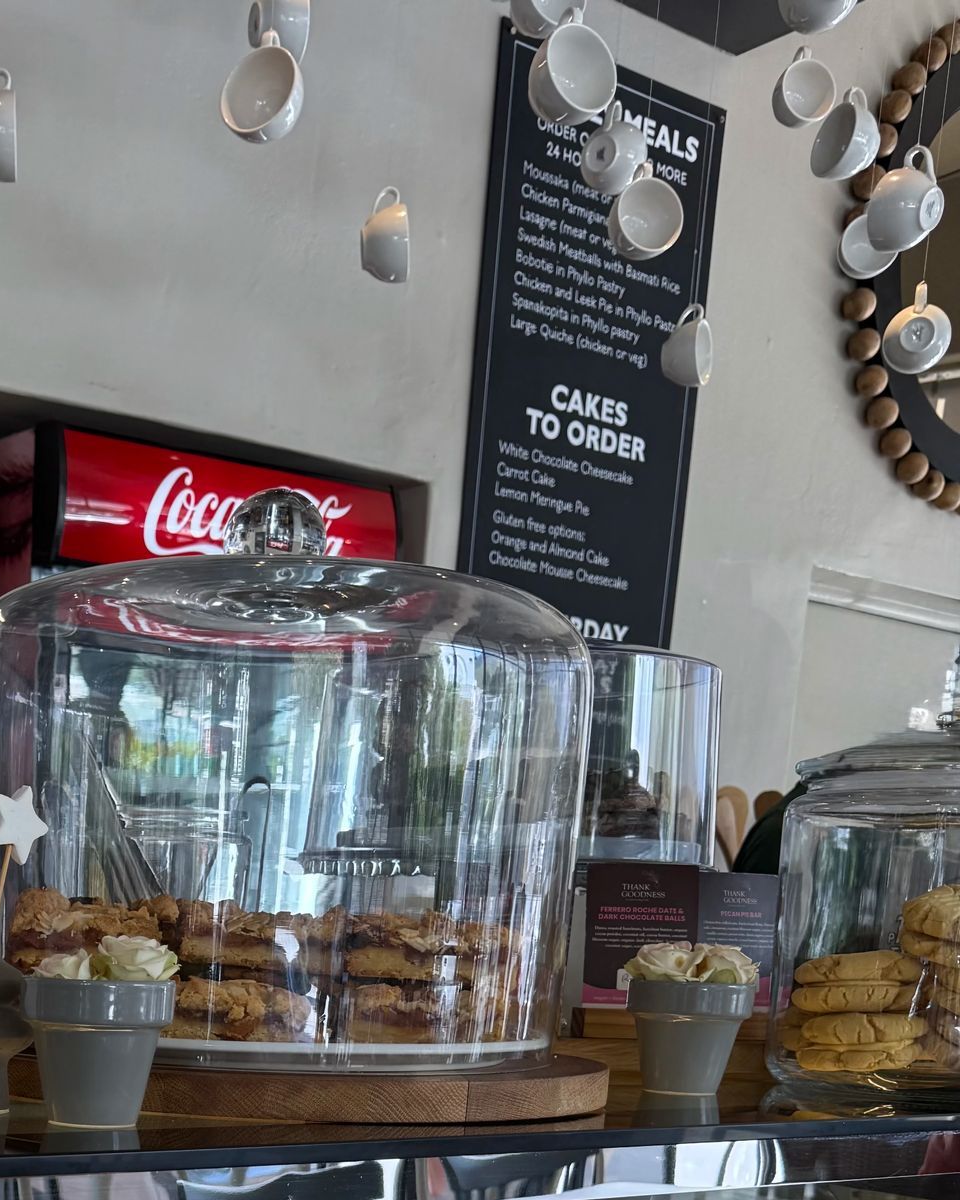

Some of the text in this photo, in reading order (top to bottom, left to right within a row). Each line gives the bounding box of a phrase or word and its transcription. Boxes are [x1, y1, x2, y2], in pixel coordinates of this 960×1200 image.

[537, 116, 577, 143] ORDER
[523, 160, 613, 205] Moussaka (meat or
[546, 141, 688, 186] 24 HO MORE
[521, 183, 560, 209] Chicken
[519, 205, 558, 231] Lasagne
[559, 219, 587, 240] (meat
[589, 233, 601, 245] or
[515, 249, 626, 299] Bobotie in Phyllo Pastry
[517, 227, 681, 295] Swedish Meatballs with Basmati Rice
[512, 292, 640, 345] Spanakopita in Phyllo pastry
[514, 271, 677, 333] Chicken and Leek Pie in Phyllo Pastr
[510, 314, 648, 370] Large Quiche (chicken or veg)
[551, 384, 629, 427] CAKES
[526, 407, 646, 462] TO ORDER
[497, 461, 556, 488] Carrot Cake
[498, 440, 634, 485] White Chocolate Cheesecake
[494, 481, 590, 516] Lemon Meringue Pie
[493, 509, 586, 542] Gluten free options:
[491, 530, 610, 567] Orange and Almond Cake
[489, 550, 629, 591] Chocolate Mousse Cheesecake
[621, 891, 666, 899] GOODNESS
[622, 883, 650, 891] THANK
[664, 914, 685, 922] BALLS
